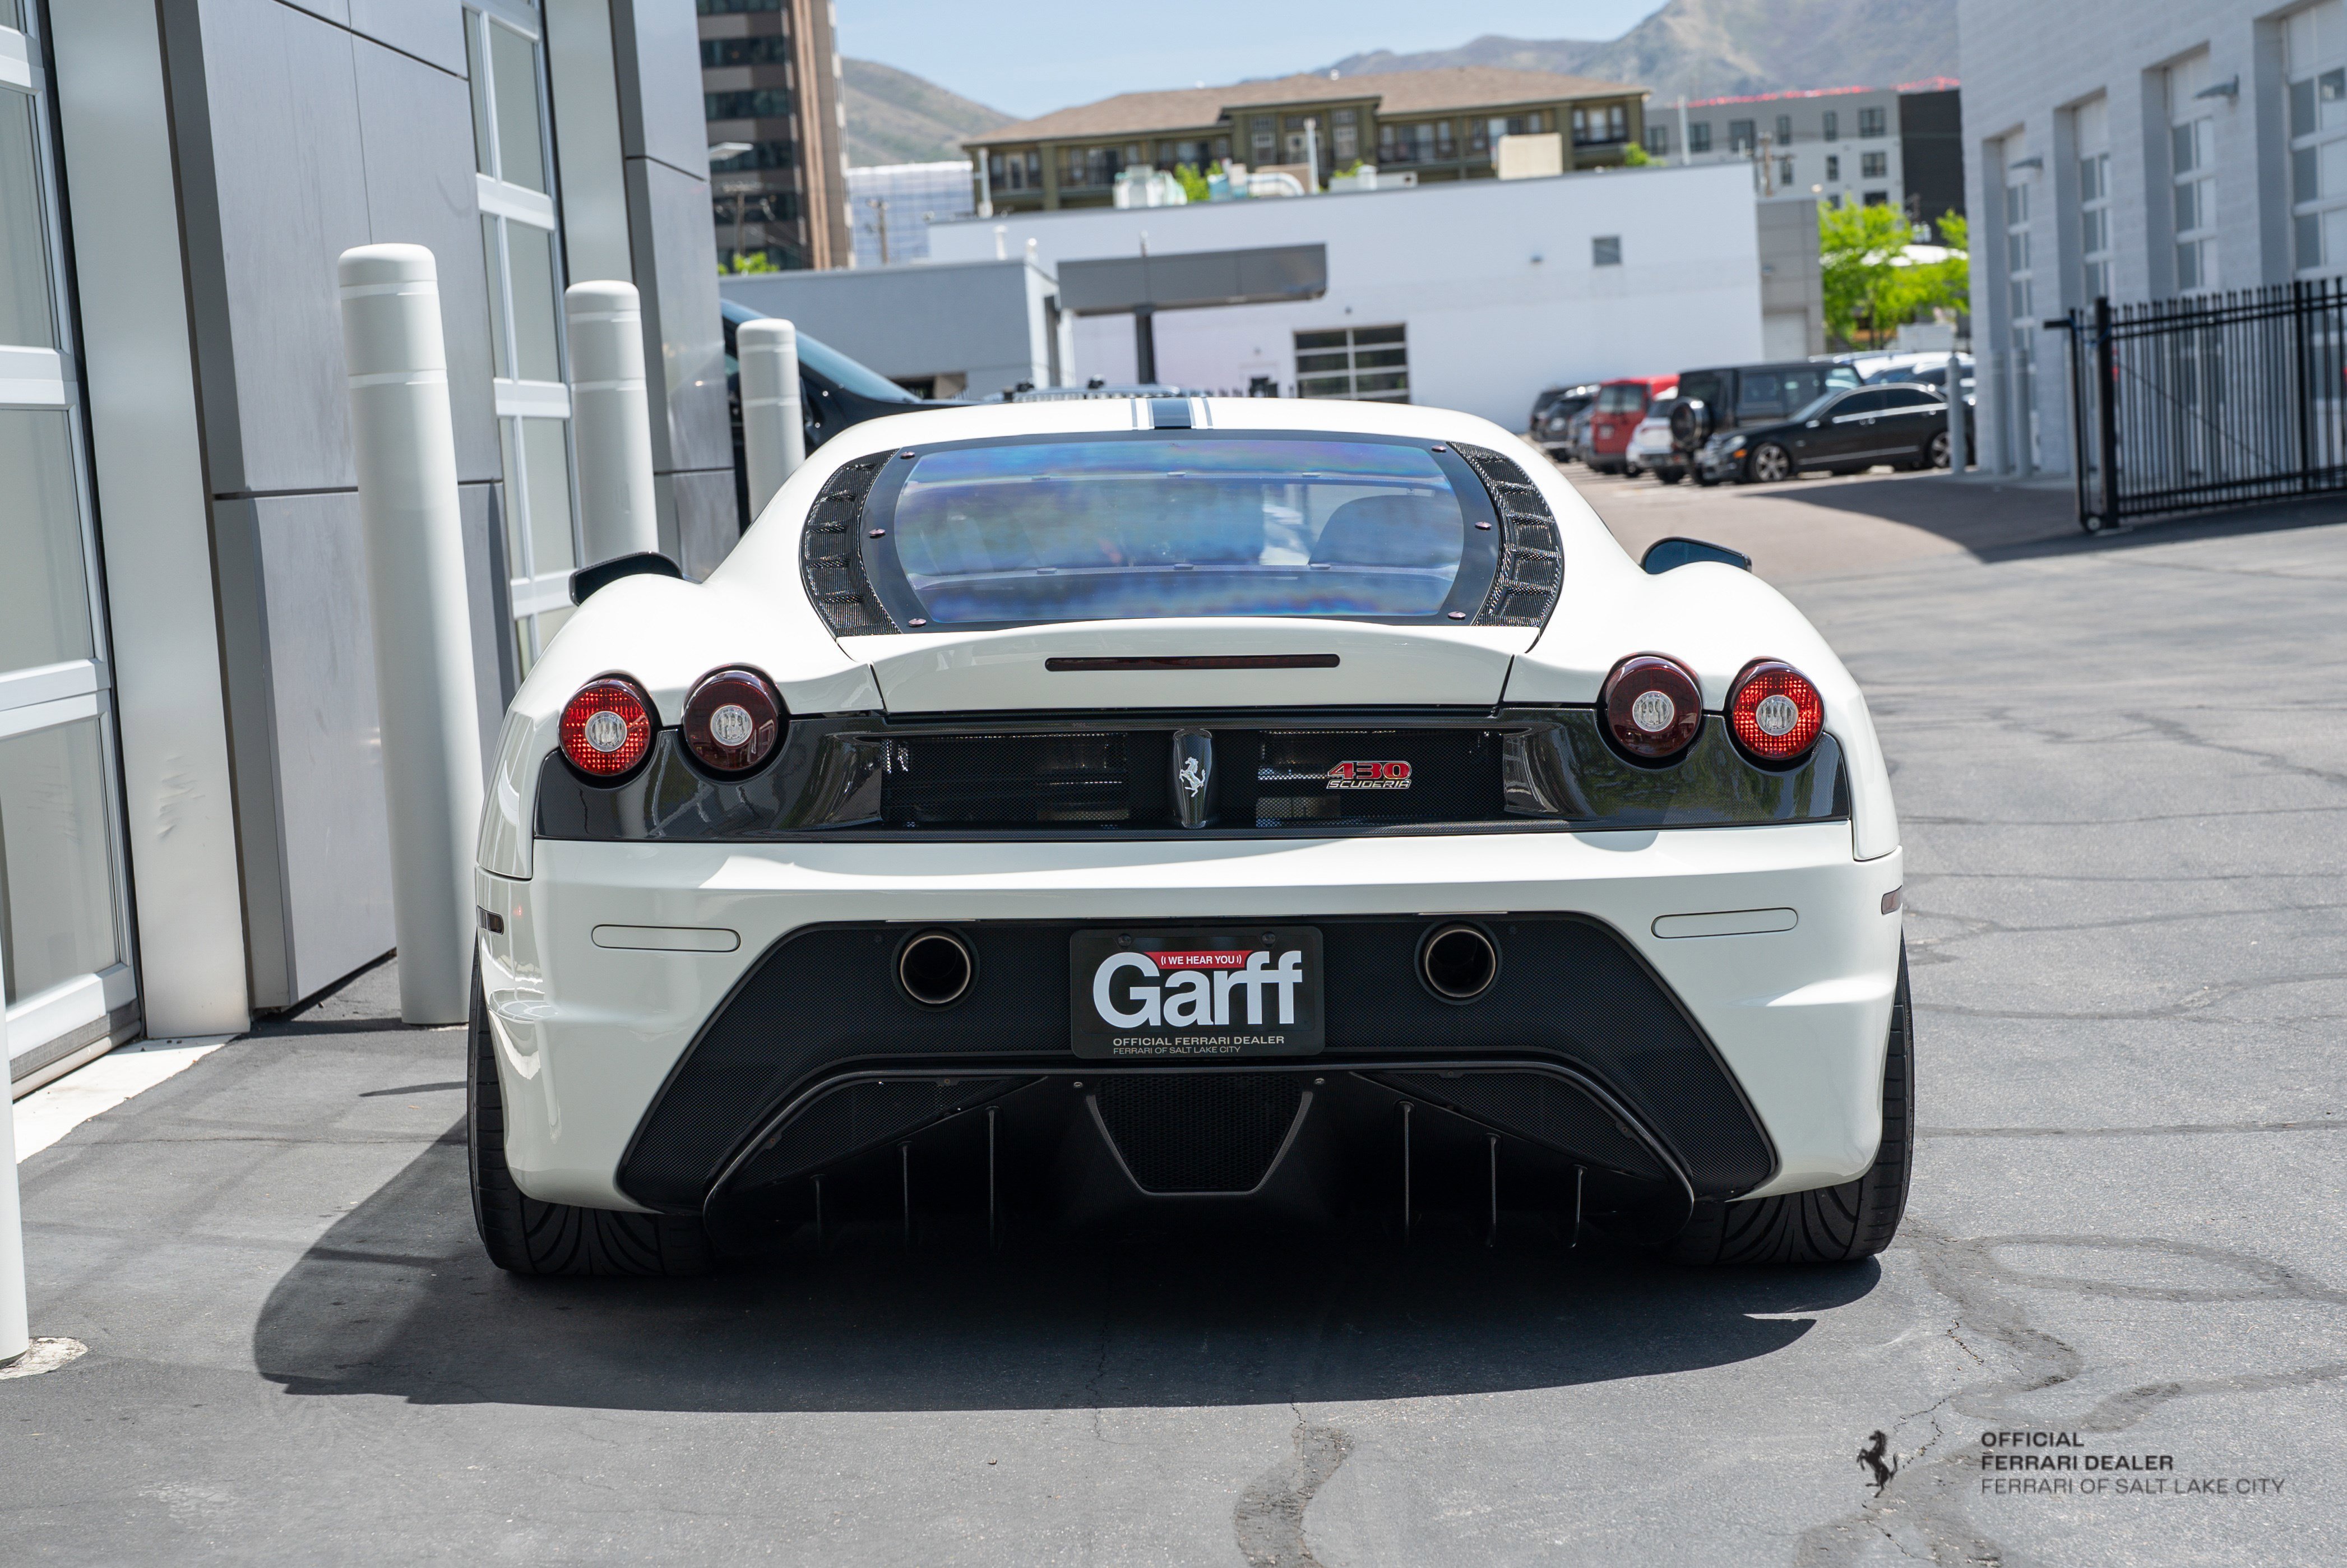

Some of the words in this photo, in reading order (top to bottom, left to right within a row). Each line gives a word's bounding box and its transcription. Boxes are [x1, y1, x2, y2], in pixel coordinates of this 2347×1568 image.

[1328, 761, 1411, 780] 430
[1328, 780, 1410, 788] SCUDERIA
[1168, 956, 1184, 965] WE
[1186, 955, 1213, 965] HEAR
[1214, 955, 1235, 964] YOU
[1093, 950, 1303, 1028] Garff
[1113, 1037, 1172, 1046] OFFICIAL
[1175, 1037, 1230, 1046] FERRARI
[1234, 1035, 1284, 1044] DEALER
